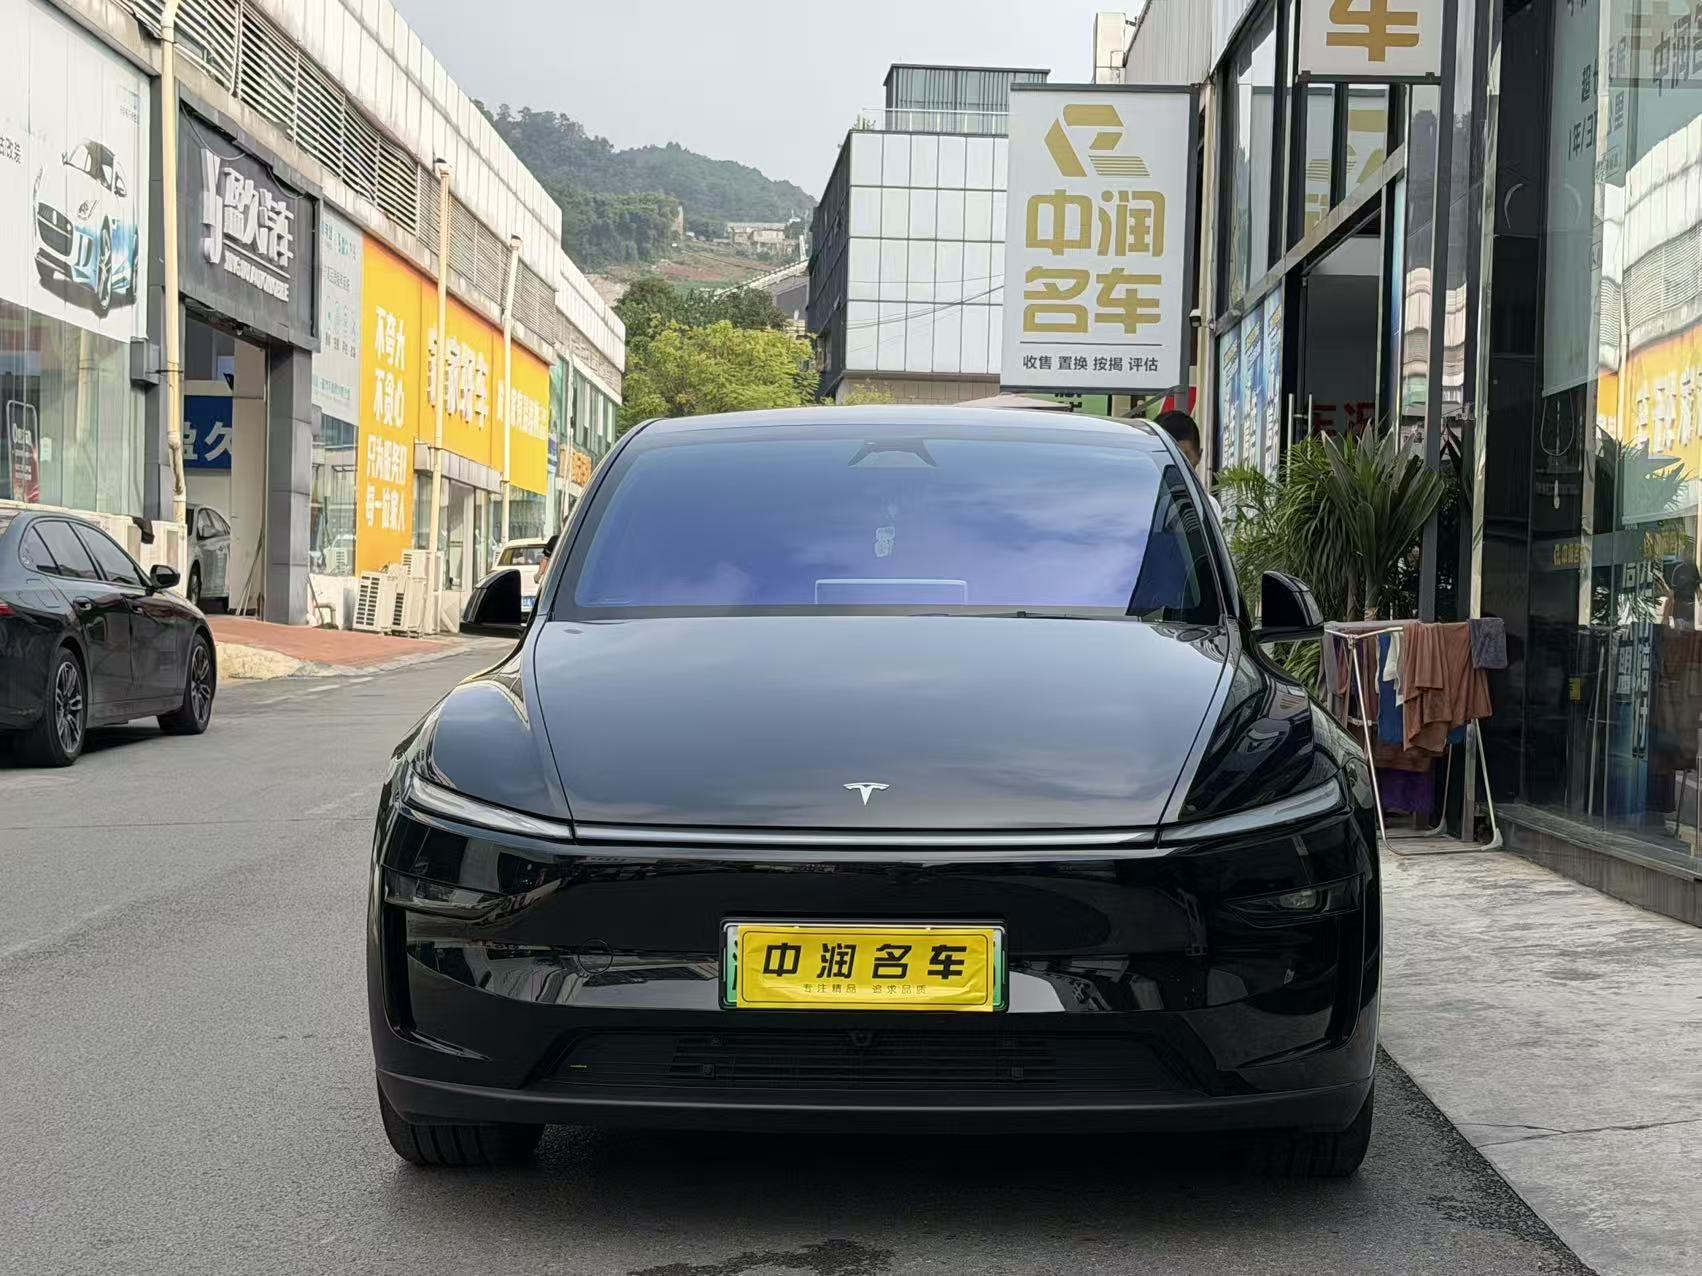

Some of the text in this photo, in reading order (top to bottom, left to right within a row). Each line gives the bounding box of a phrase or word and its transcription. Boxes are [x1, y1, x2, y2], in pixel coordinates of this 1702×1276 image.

[1025, 188, 1166, 258] 中润
[1022, 265, 1162, 335] 名车
[1022, 354, 1159, 373] 收售 置换 按揭 评估
[762, 942, 968, 980] 中润名车
[802, 983, 928, 995] 专注精品 追求品质
